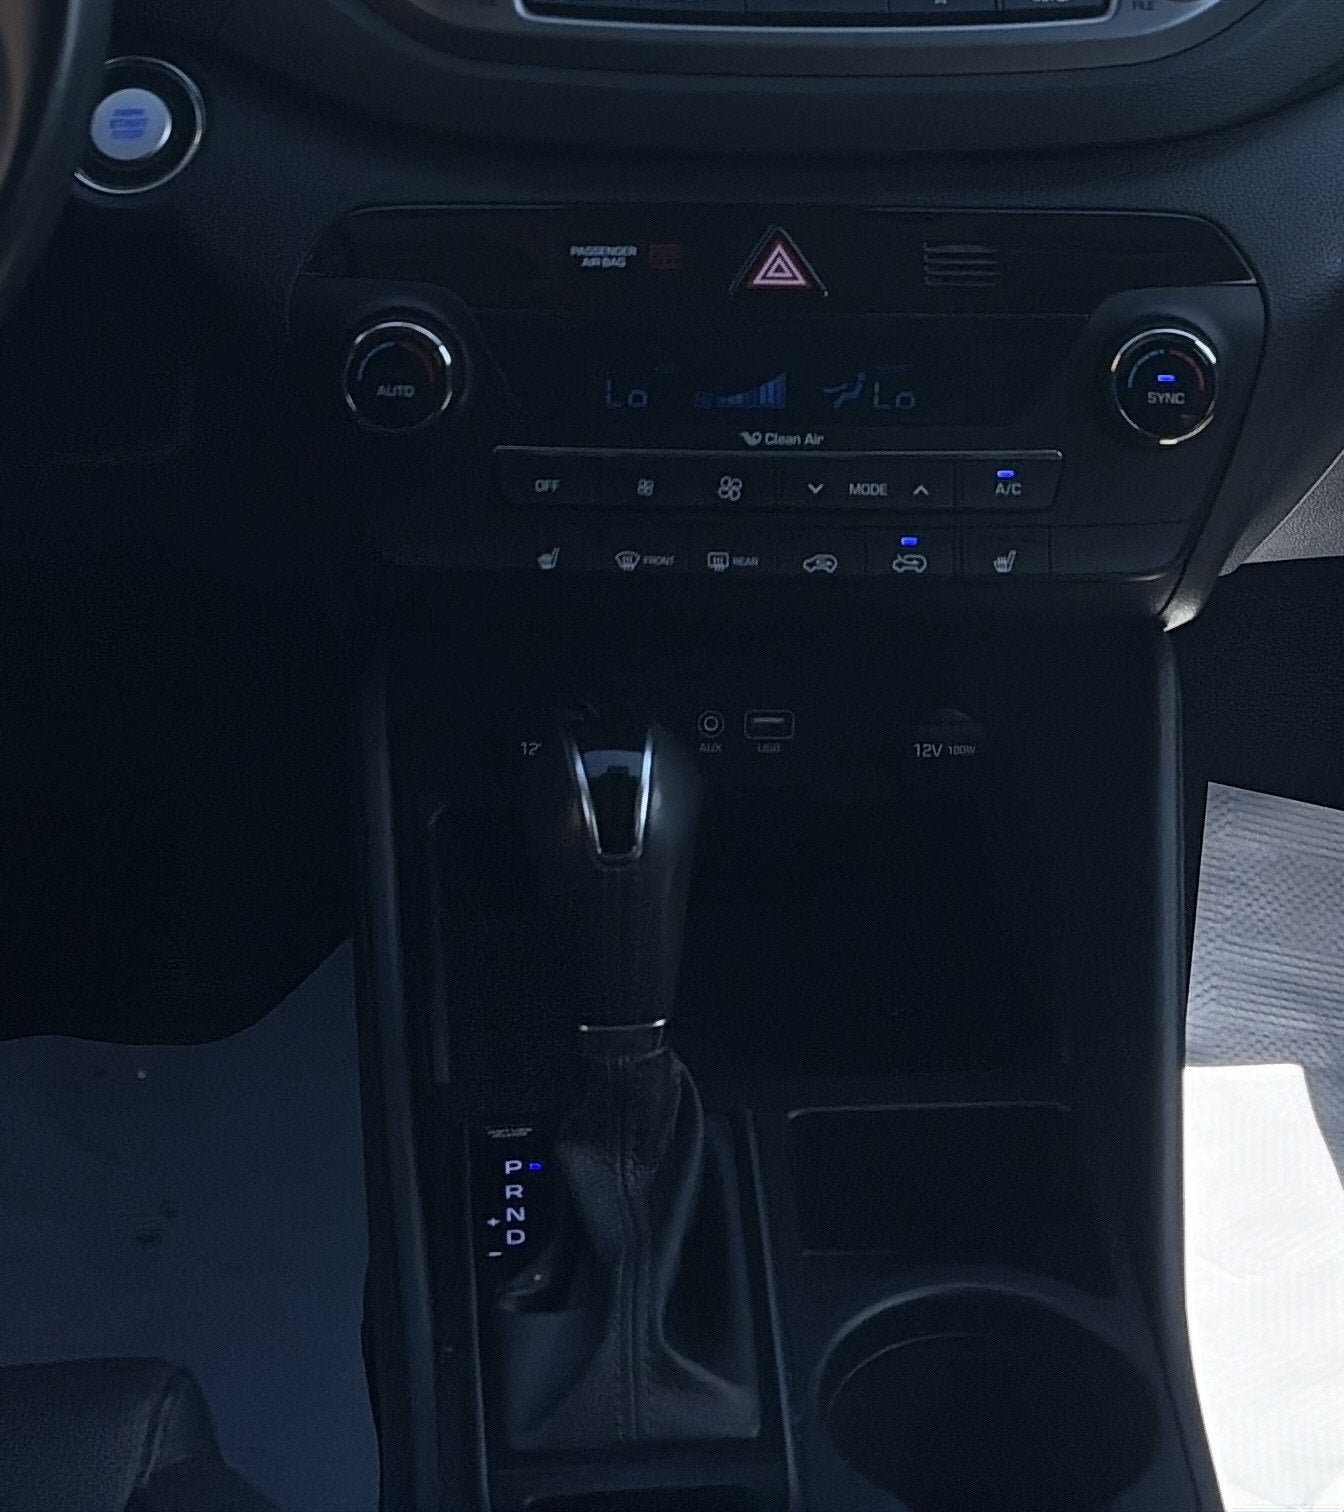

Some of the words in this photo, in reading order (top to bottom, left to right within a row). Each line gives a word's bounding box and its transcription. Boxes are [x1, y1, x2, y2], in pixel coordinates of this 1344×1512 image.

[375, 384, 415, 399] AUTO
[872, 381, 917, 411] Lo
[1146, 391, 1185, 406] SYNC
[765, 433, 801, 445] Clean
[805, 433, 824, 445] Air
[534, 480, 561, 493] OFF
[848, 483, 888, 497] MODE
[994, 482, 1022, 497] A/C
[914, 743, 943, 758] 12V
[504, 1159, 523, 1175] P
[505, 1184, 524, 1200] R
[506, 1206, 526, 1223] N
[506, 1228, 526, 1245] D
